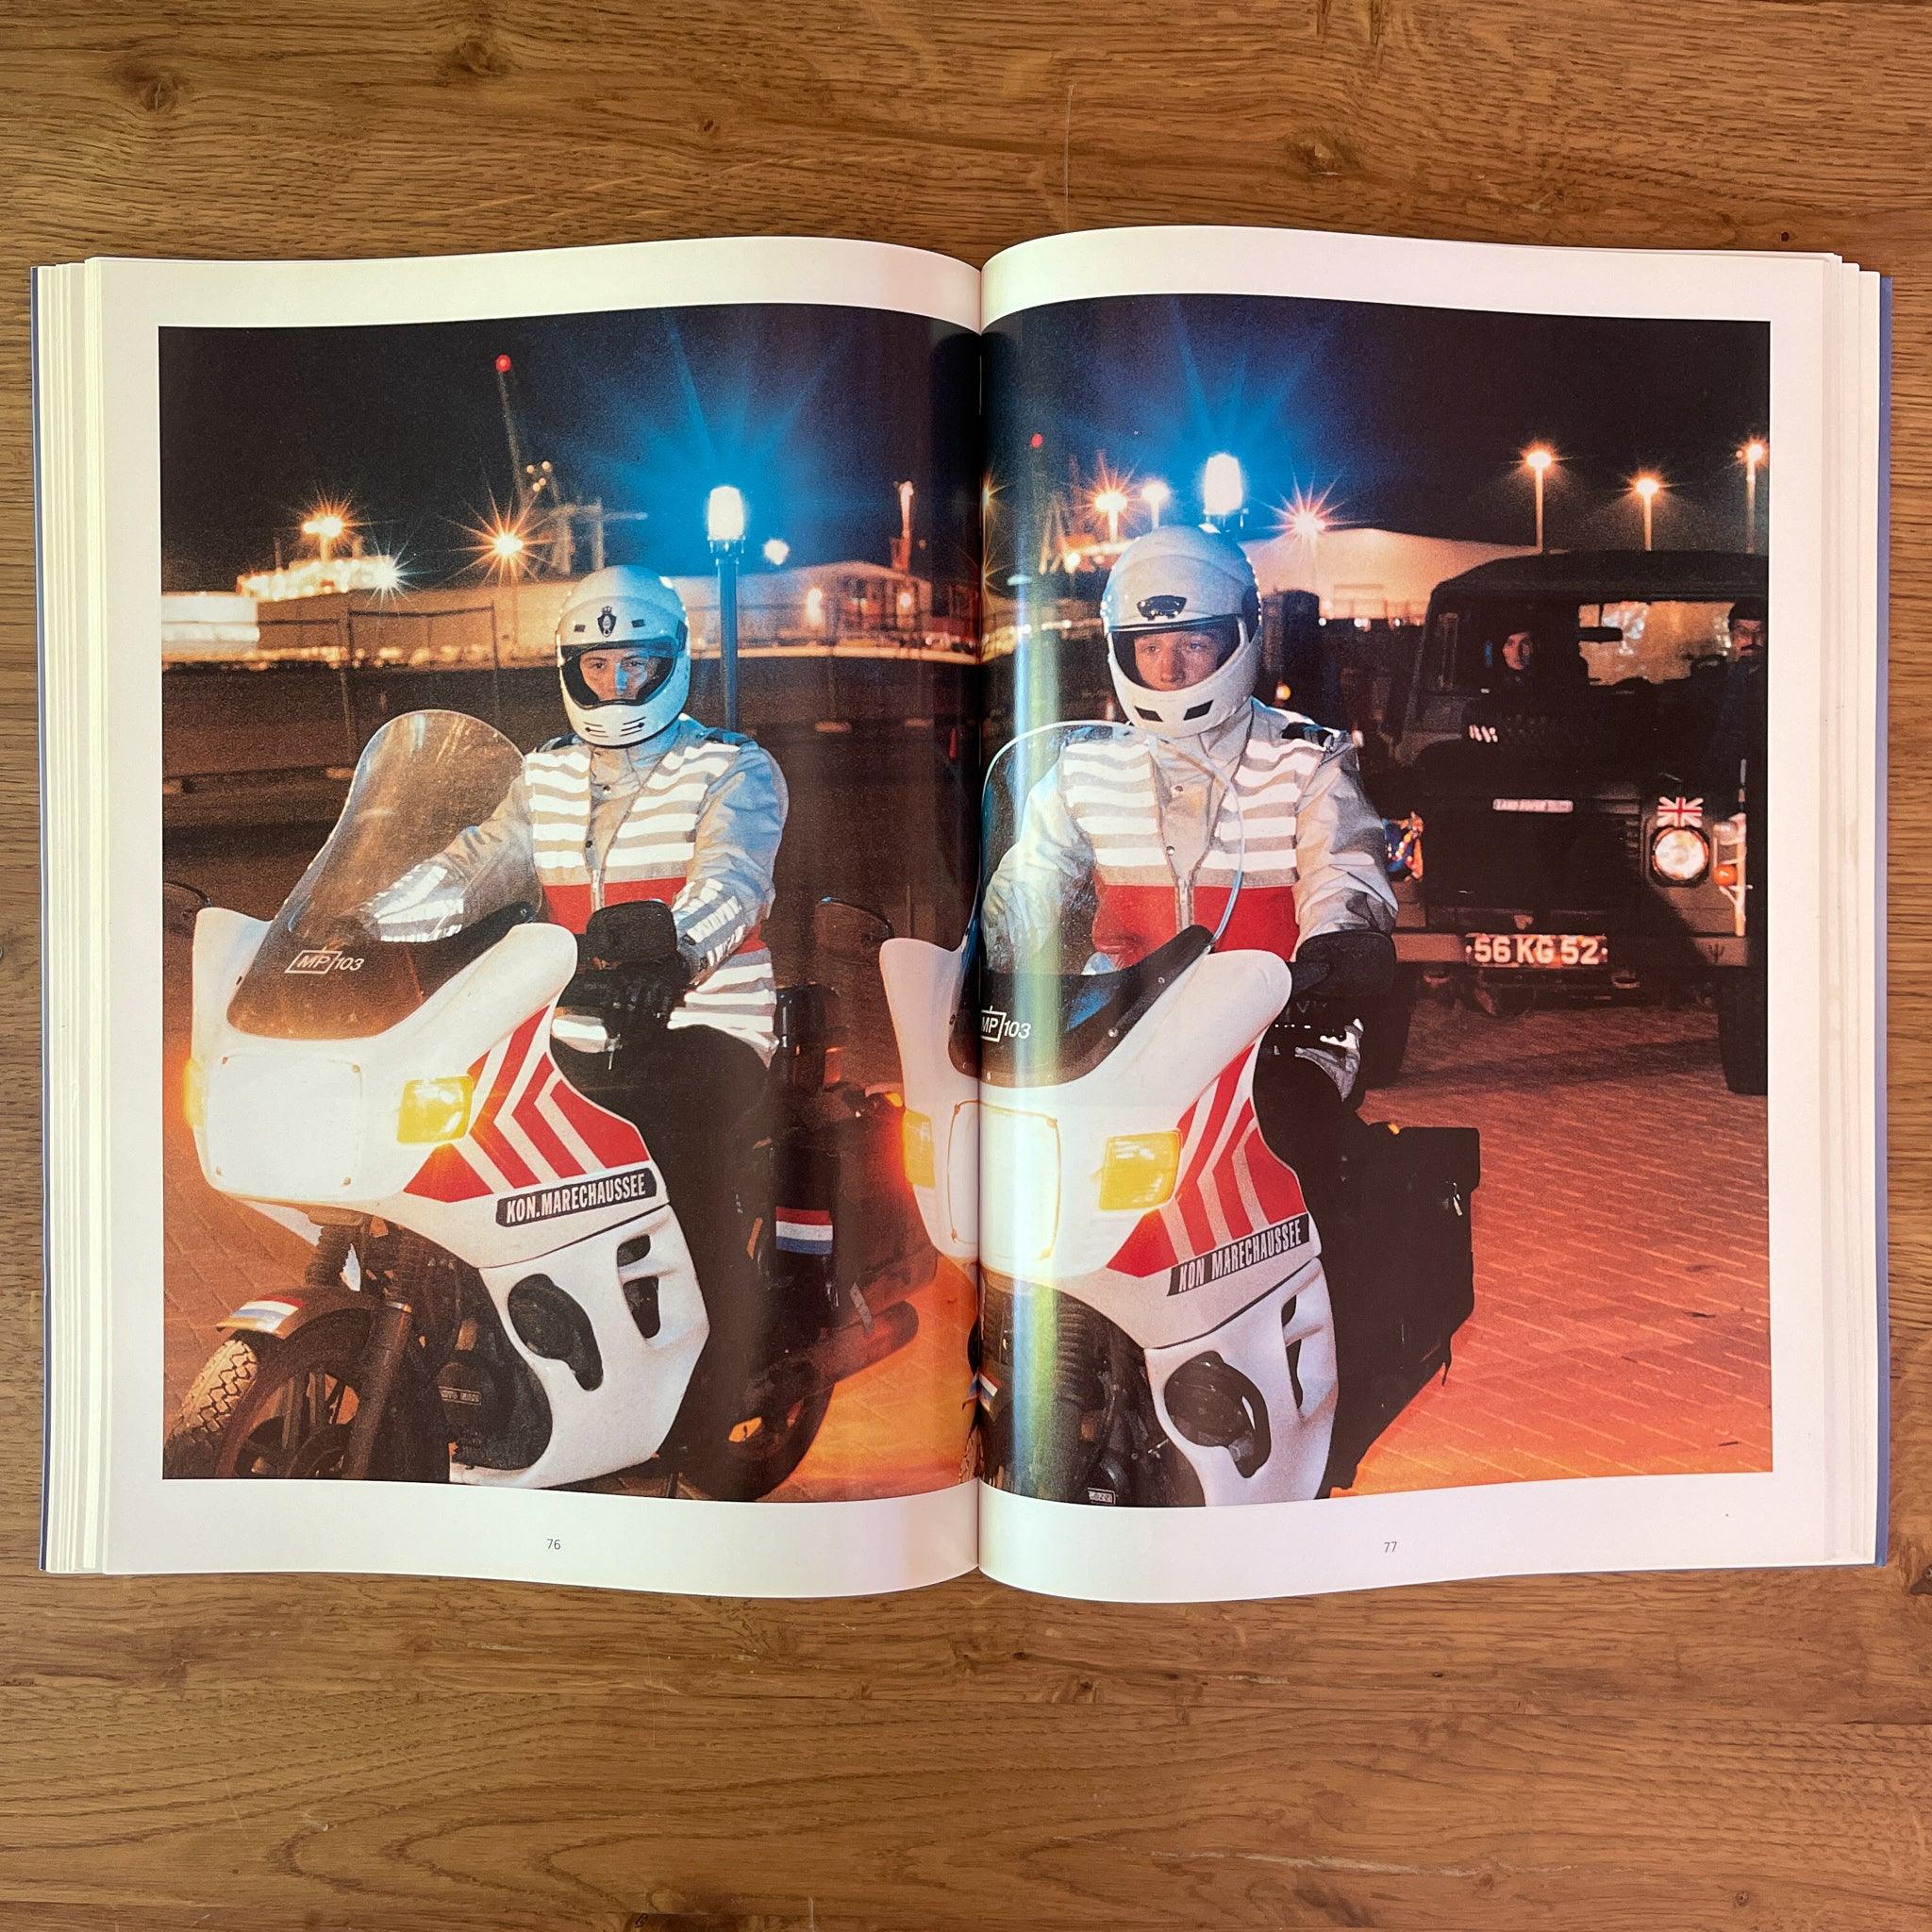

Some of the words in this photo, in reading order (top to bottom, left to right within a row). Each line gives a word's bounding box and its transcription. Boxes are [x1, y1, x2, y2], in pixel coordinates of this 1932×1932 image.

[1474, 933, 1510, 963] 56
[1516, 934, 1555, 964] KG
[1560, 935, 1600, 965] 52
[296, 955, 331, 969] MP
[334, 957, 365, 971] 103
[982, 1016, 999, 1034] MP
[1004, 1020, 1031, 1040] 103
[1179, 1257, 1205, 1292] KON
[1211, 1219, 1302, 1280] MARECHAUSSEE
[546, 1538, 561, 1550] 76
[1384, 1541, 1397, 1553] 77
